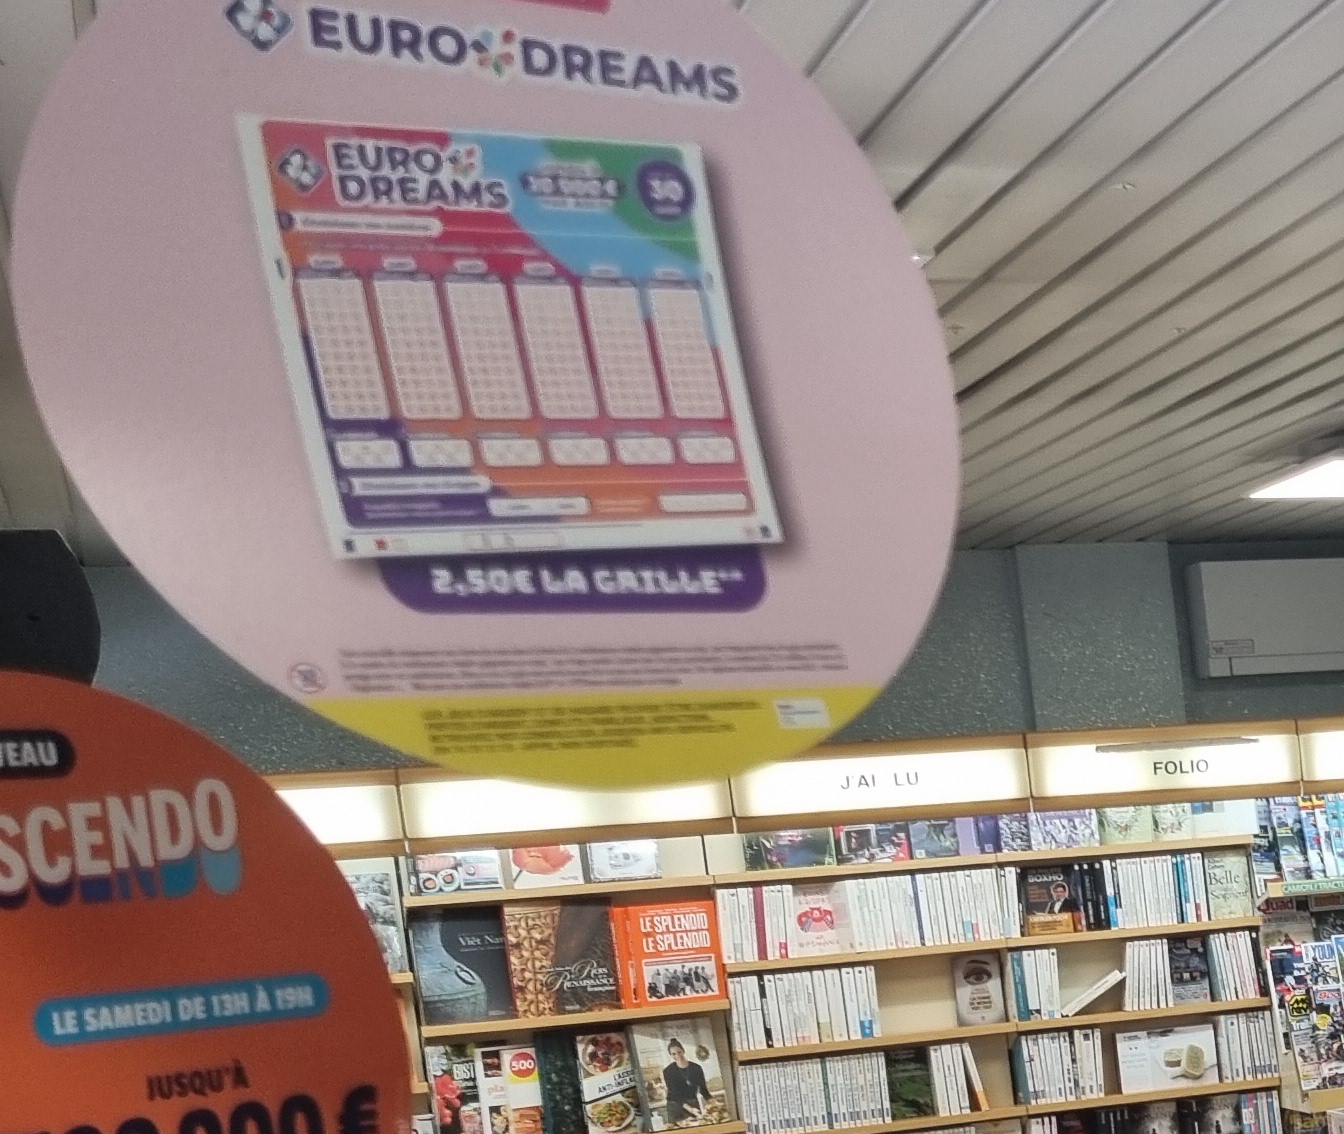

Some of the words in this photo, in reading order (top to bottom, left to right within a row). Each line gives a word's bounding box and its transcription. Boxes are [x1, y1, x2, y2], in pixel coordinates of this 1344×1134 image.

[332, 141, 443, 174] EURO
[339, 175, 511, 210] DREAMS
[1152, 758, 1209, 777] FOLIO
[840, 773, 877, 790] J'AI
[893, 771, 920, 787] LU
[653, 913, 708, 931] SPLENDID
[657, 930, 710, 950] SPLENDID
[52, 1010, 79, 1036] LE
[83, 998, 172, 1032] SAMEDI
[178, 996, 207, 1021] DE
[210, 991, 251, 1017] 13H
[511, 1059, 535, 1071] 500
[146, 1059, 249, 1100] JUSQU'À
